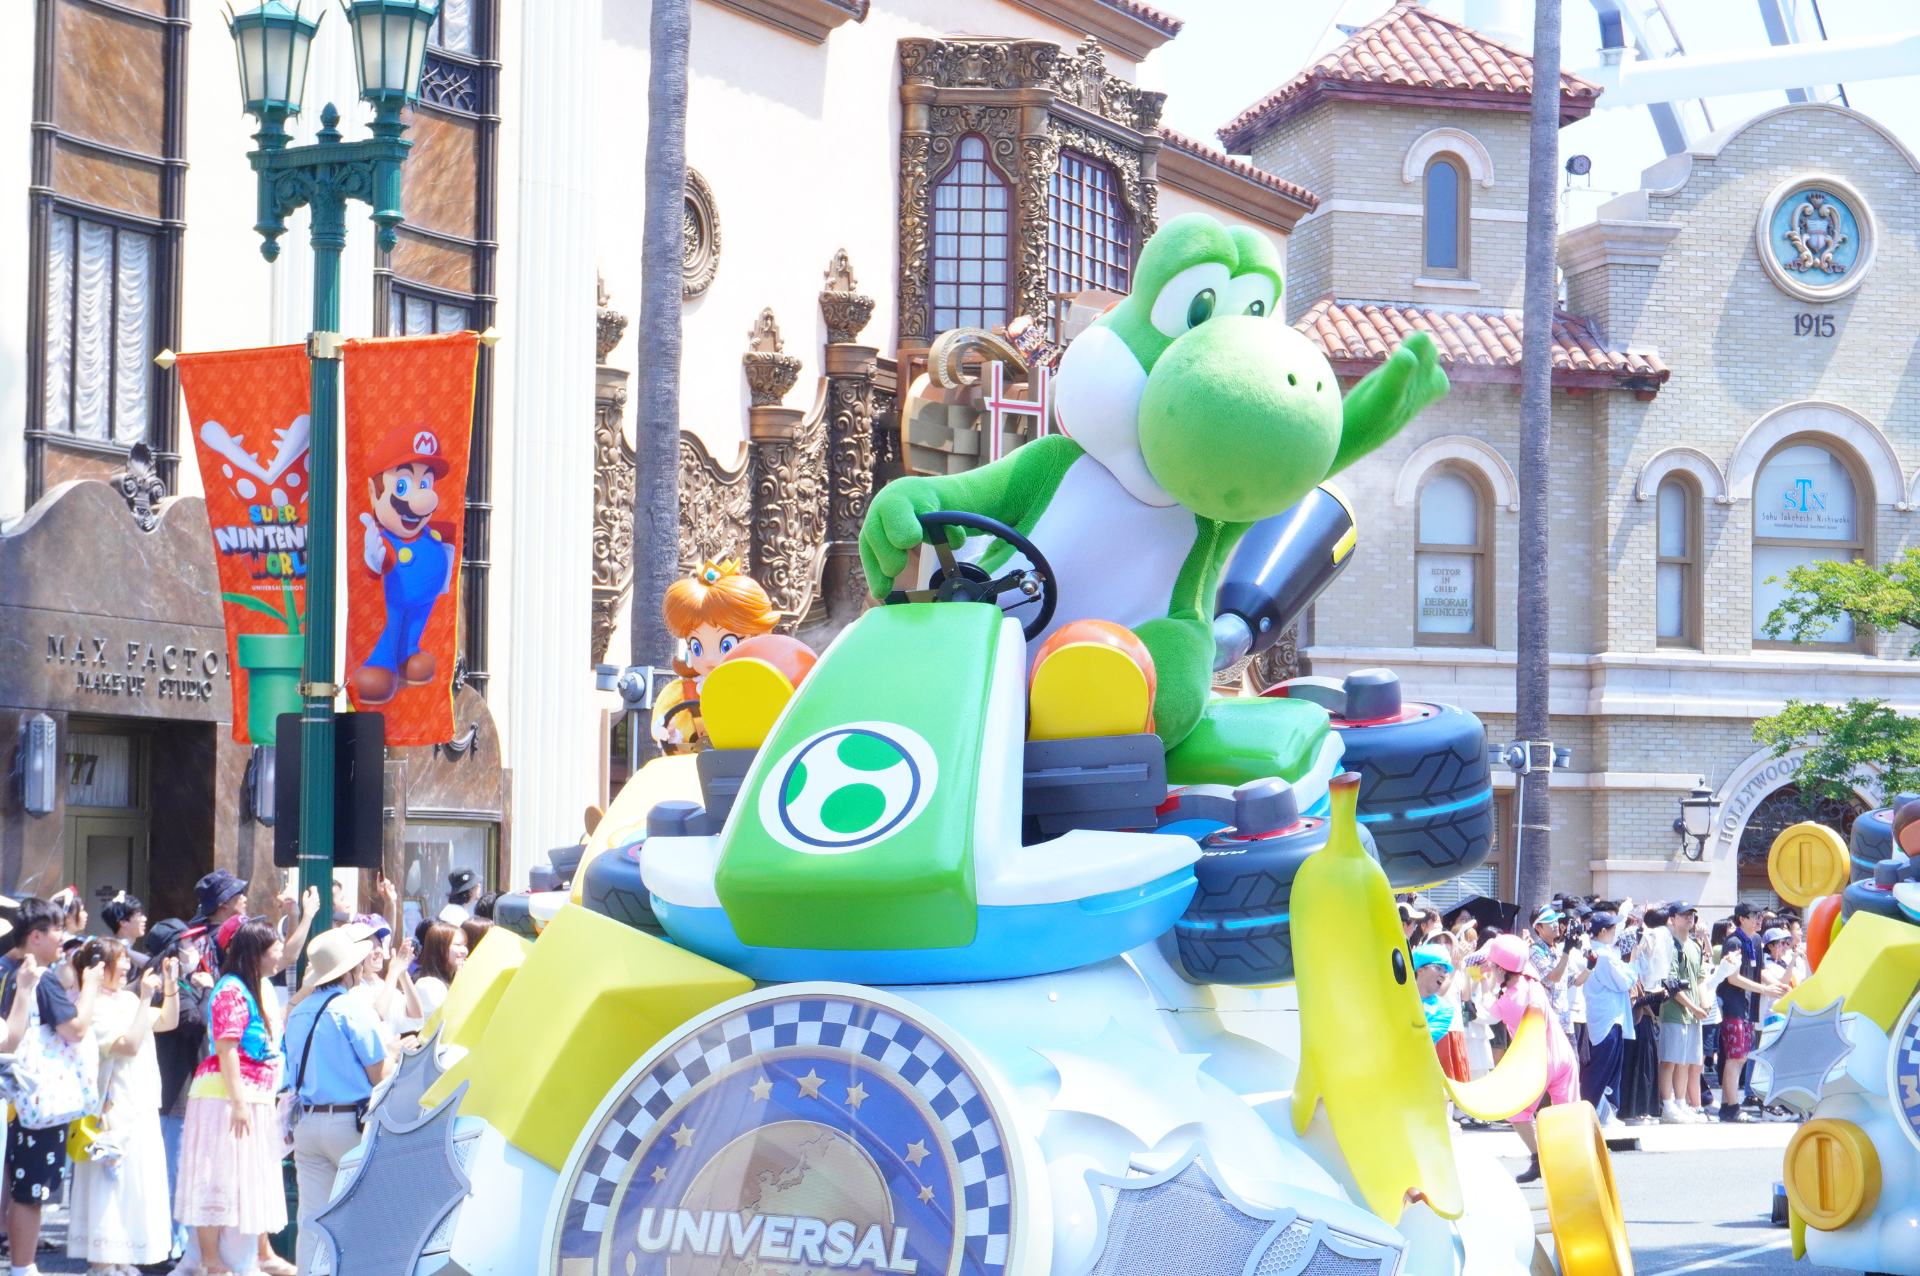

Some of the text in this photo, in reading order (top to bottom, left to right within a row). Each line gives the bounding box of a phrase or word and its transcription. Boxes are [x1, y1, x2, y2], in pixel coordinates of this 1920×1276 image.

[1794, 313, 1836, 338] 1915
[1783, 478, 1829, 513] STN
[248, 504, 300, 525] SUPER
[241, 552, 307, 579] WORL
[1431, 568, 1461, 576] EDITOR
[1434, 585, 1458, 593] CHIEF
[1422, 608, 1470, 617] BRINKLEY
[1424, 598, 1468, 607] DEBORAH
[46, 634, 109, 665] MAX
[158, 677, 213, 699] STUDIO
[1719, 755, 1802, 845] HOLLYWOOD
[46, 1152, 56, 1165] 5
[637, 1207, 918, 1274] UNIVERSAL
